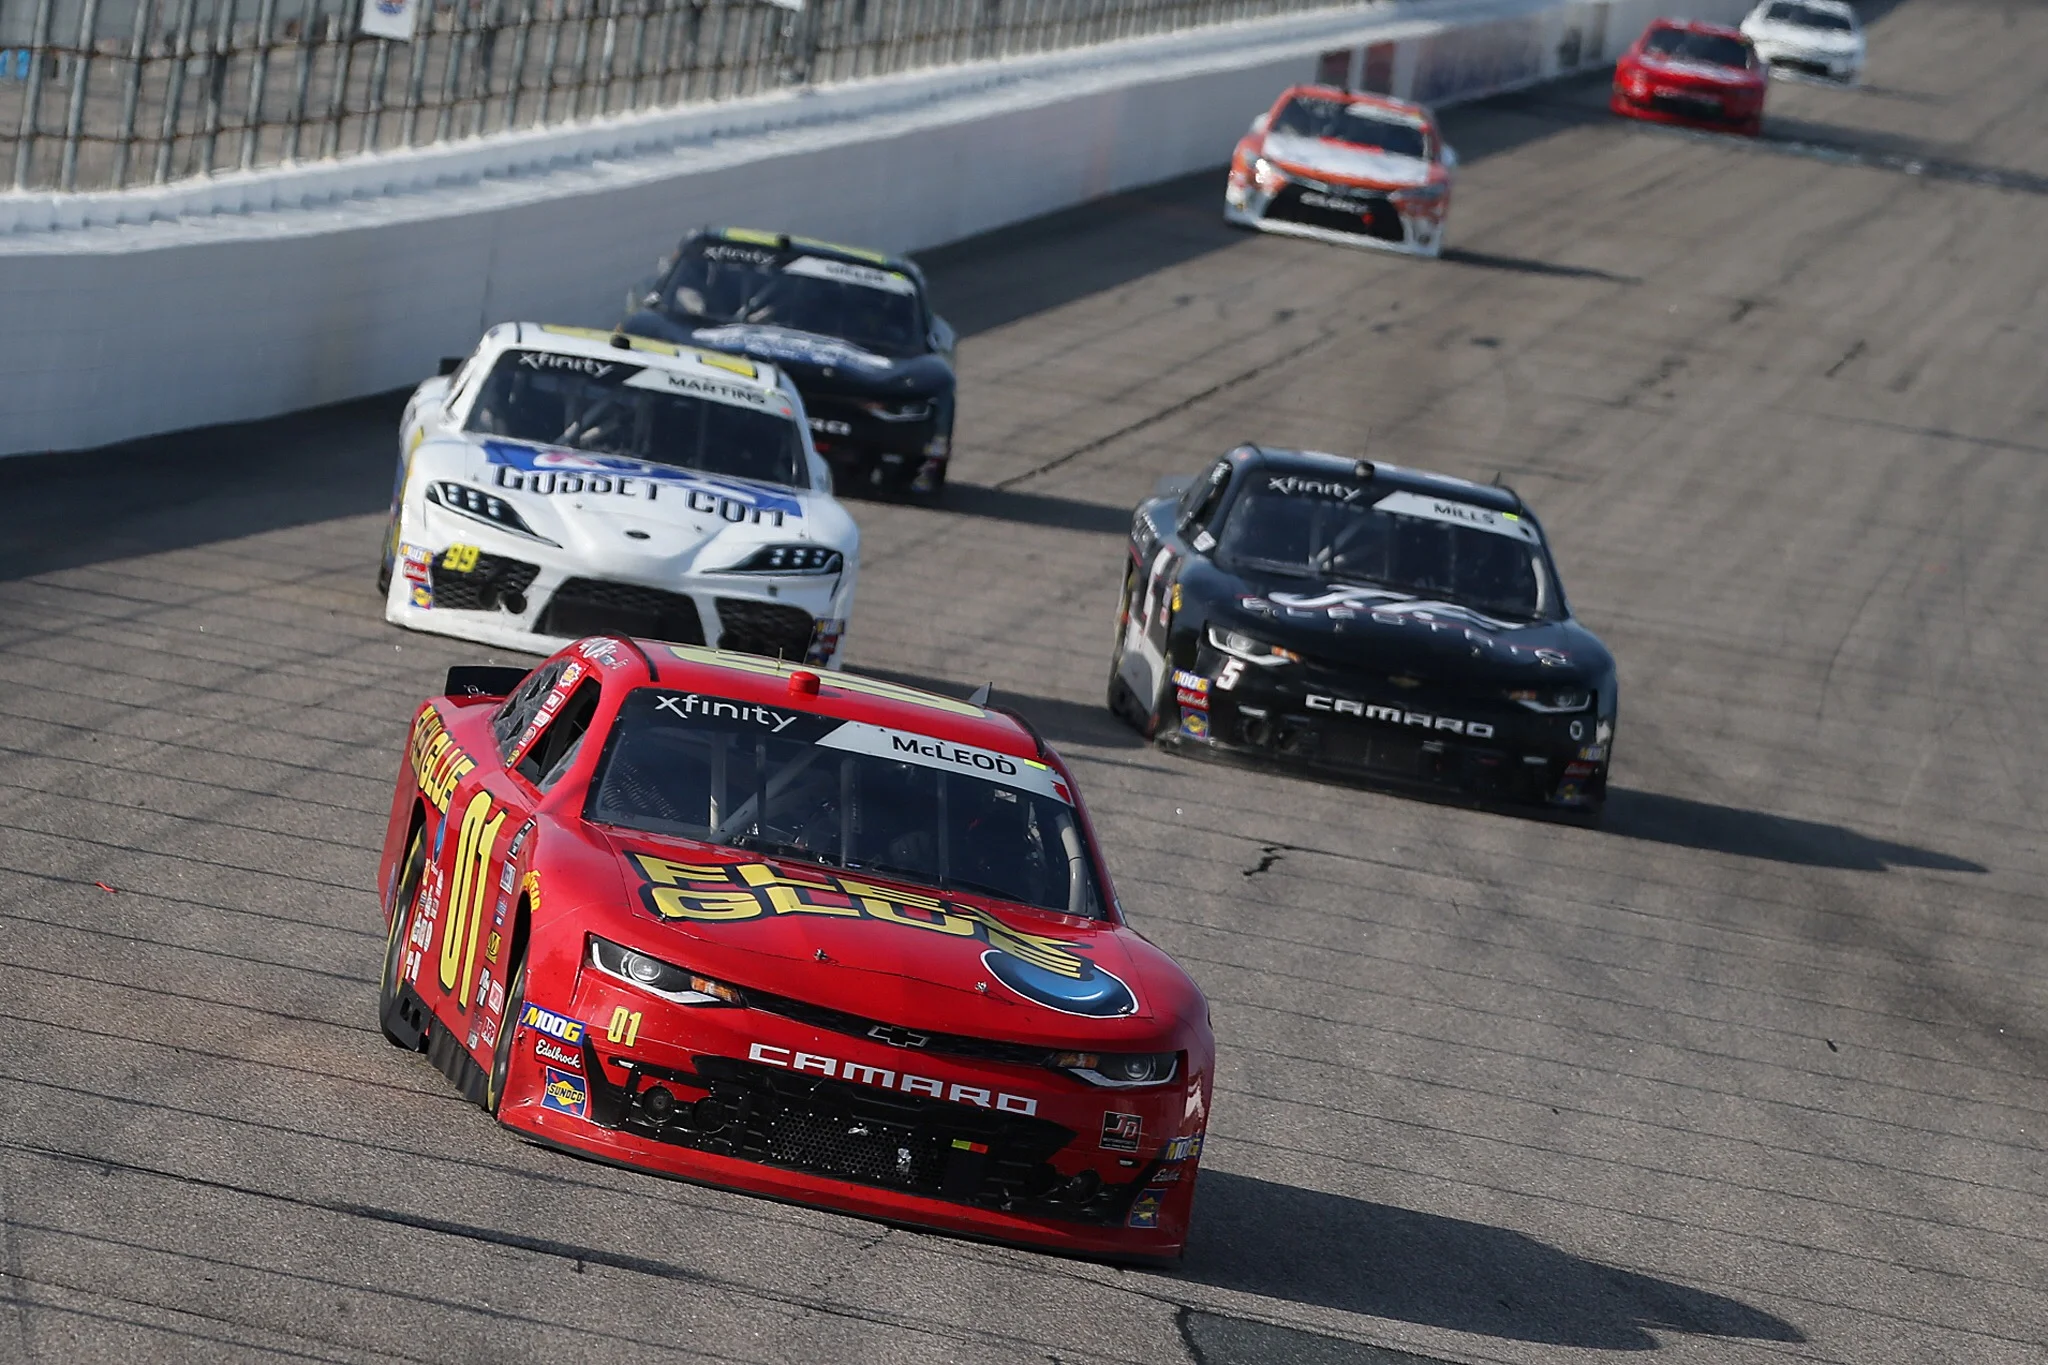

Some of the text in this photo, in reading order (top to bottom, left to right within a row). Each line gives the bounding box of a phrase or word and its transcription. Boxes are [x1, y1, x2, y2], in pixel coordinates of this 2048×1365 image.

[518, 350, 613, 377] xfinity
[667, 374, 767, 406] MARTINS
[1267, 474, 1364, 502] xfinity
[1434, 502, 1497, 526] MILLS
[442, 541, 479, 573] 99
[654, 694, 798, 734] xfinity
[1304, 693, 1494, 740] CAMARO
[891, 735, 1018, 777] McLEOD
[438, 788, 509, 1010] 01
[521, 1006, 583, 1043] MOOG
[607, 1005, 642, 1048] 01
[535, 1038, 581, 1069] Edelbrock
[548, 1083, 584, 1102] SUNOCO
[747, 1042, 1038, 1117] CAMARO
